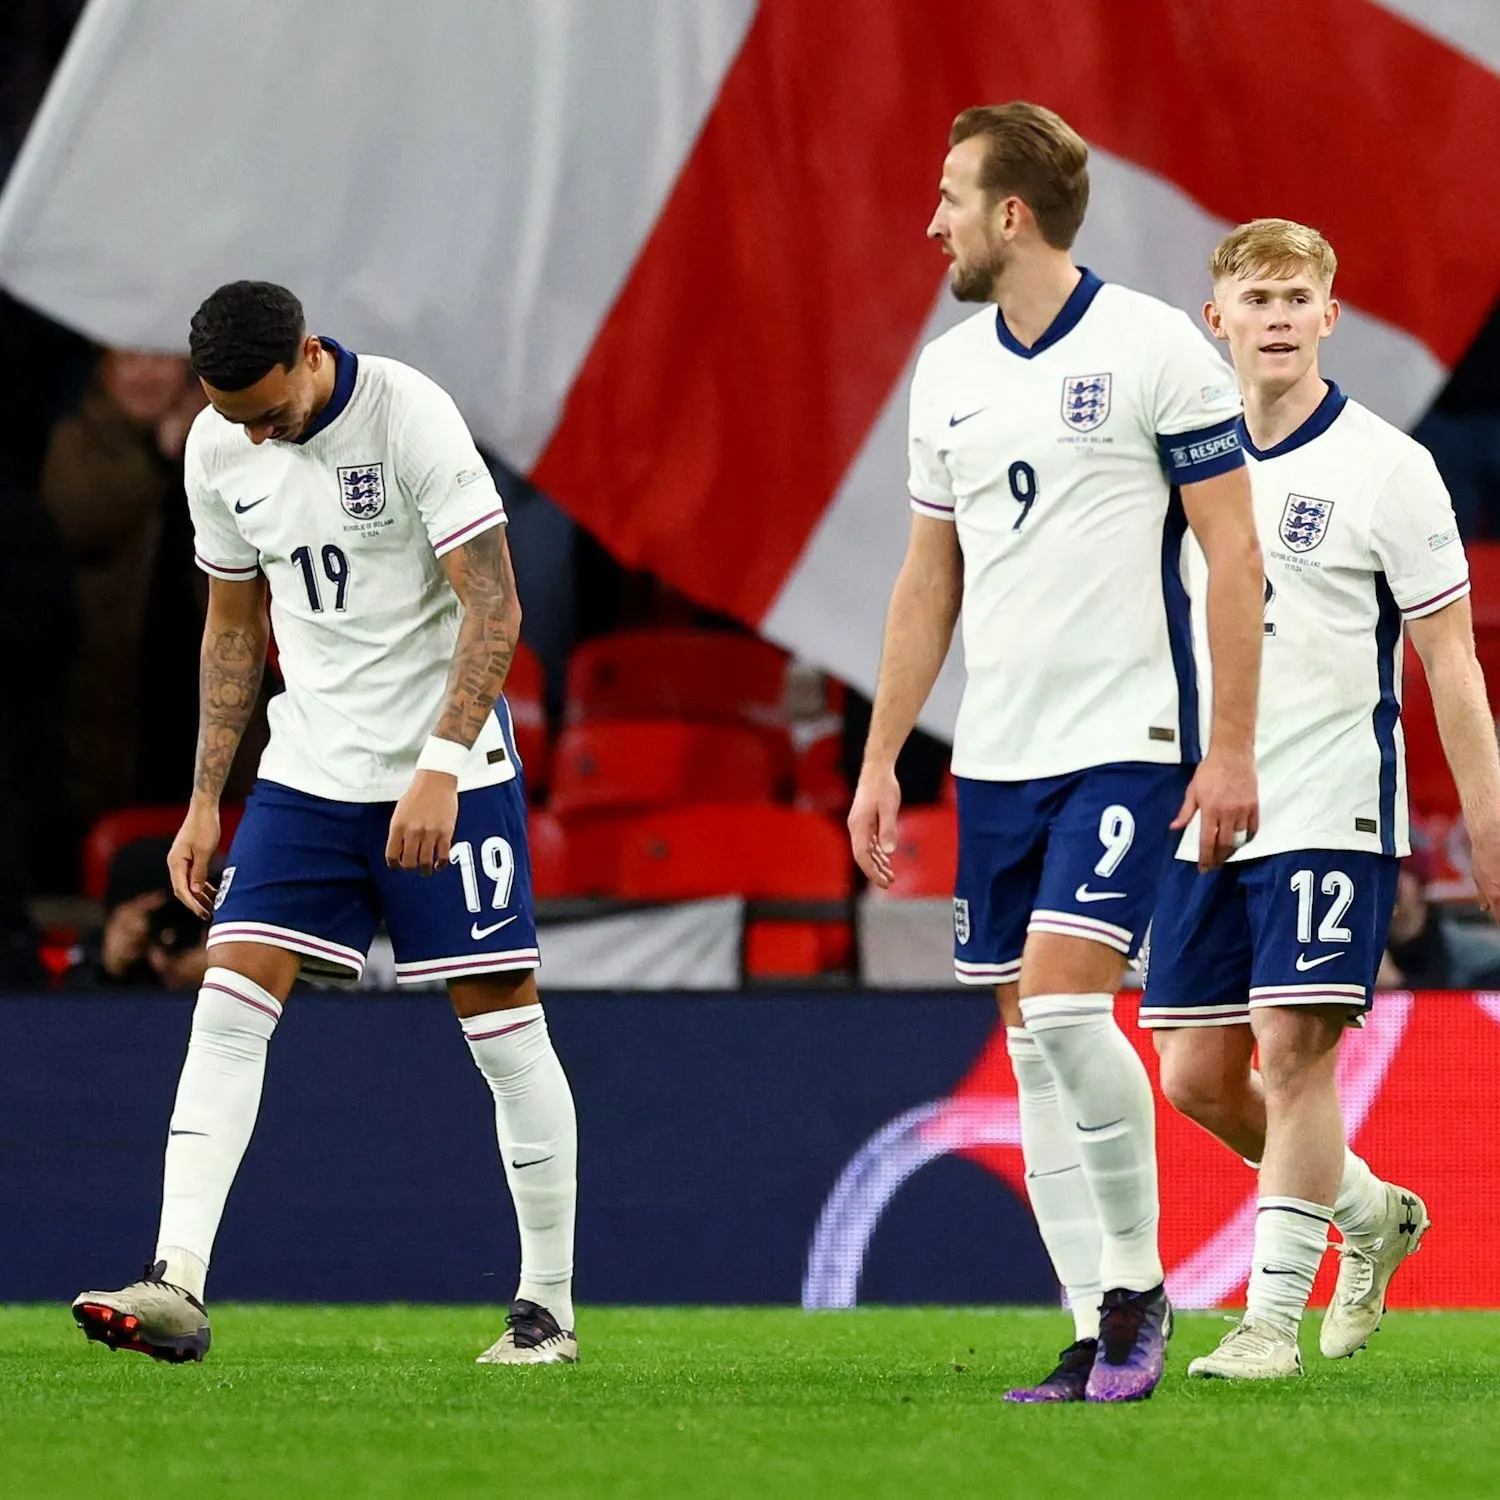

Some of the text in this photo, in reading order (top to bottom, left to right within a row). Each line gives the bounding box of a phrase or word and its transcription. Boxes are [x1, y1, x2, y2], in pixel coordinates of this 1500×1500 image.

[1189, 433, 1239, 460] RESPECT
[1008, 460, 1039, 533] 9
[291, 544, 350, 612] 19
[448, 836, 515, 913] 19
[1097, 804, 1136, 878] 9
[1290, 869, 1355, 944] 12
